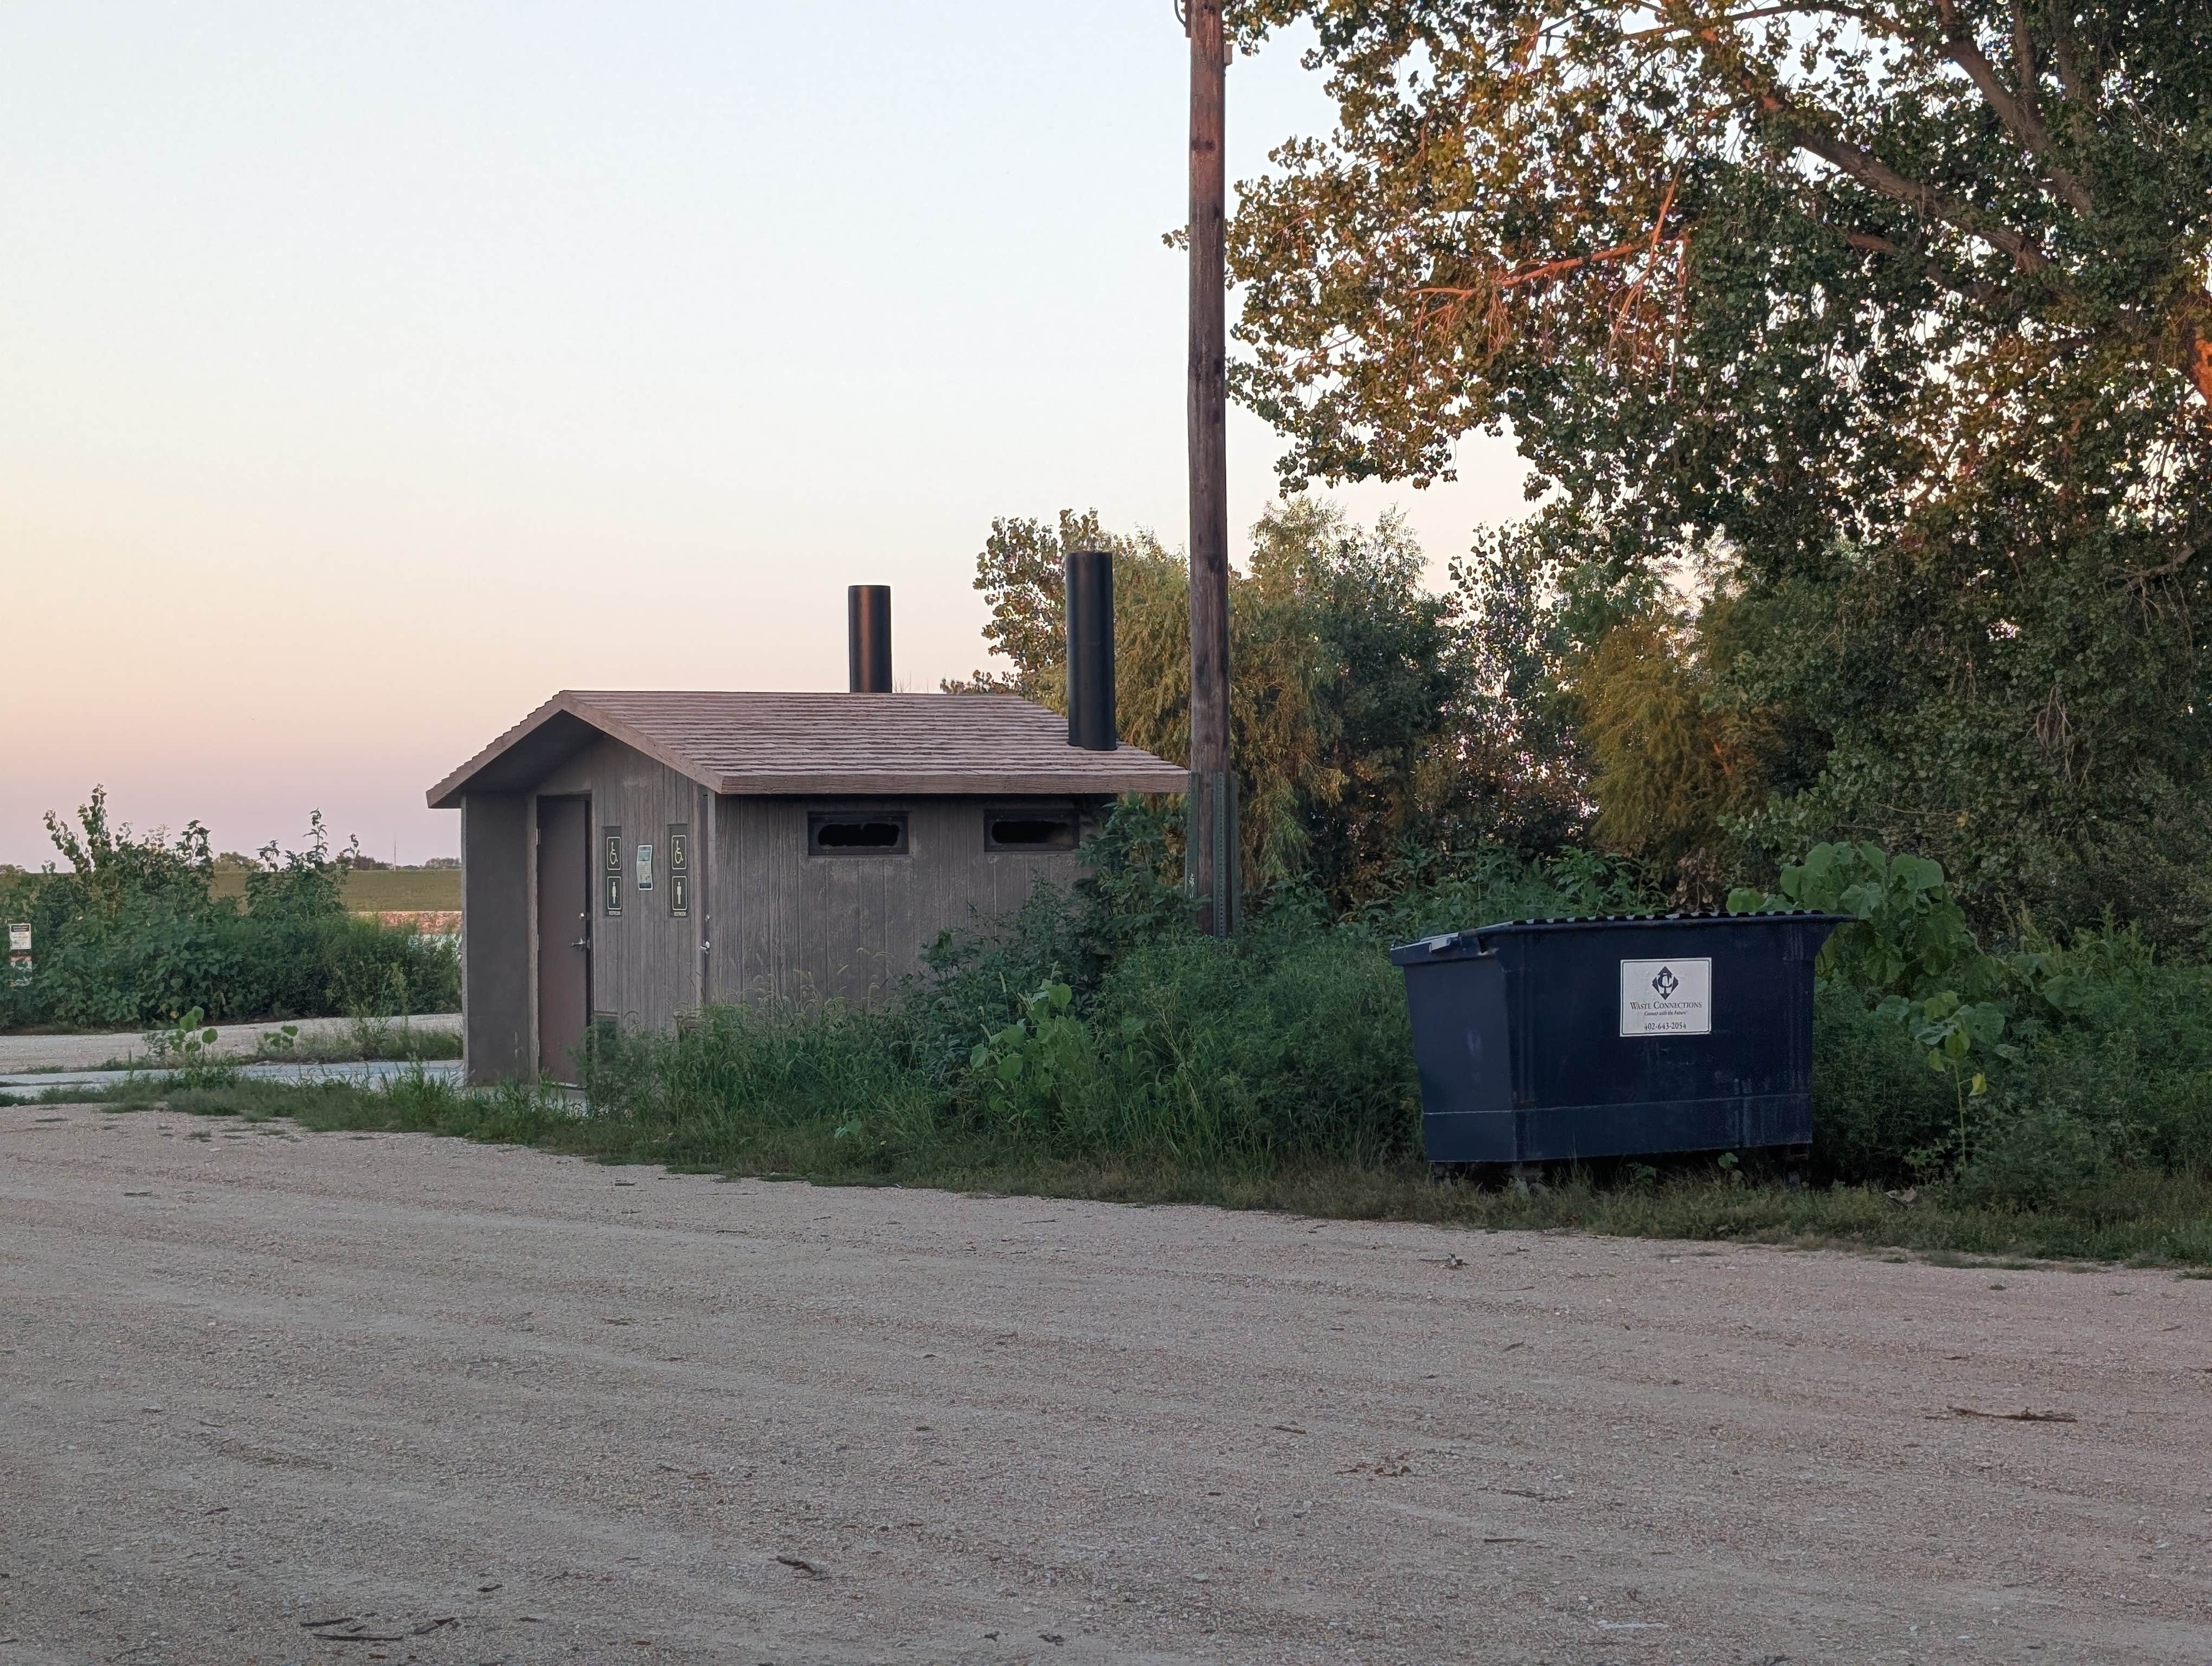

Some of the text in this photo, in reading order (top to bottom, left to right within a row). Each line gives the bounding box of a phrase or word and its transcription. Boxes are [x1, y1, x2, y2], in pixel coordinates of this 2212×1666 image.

[1630, 1001, 1702, 1010] WASTE CONNECTIONS
[1644, 1022, 1686, 1030] 402-643-2054
